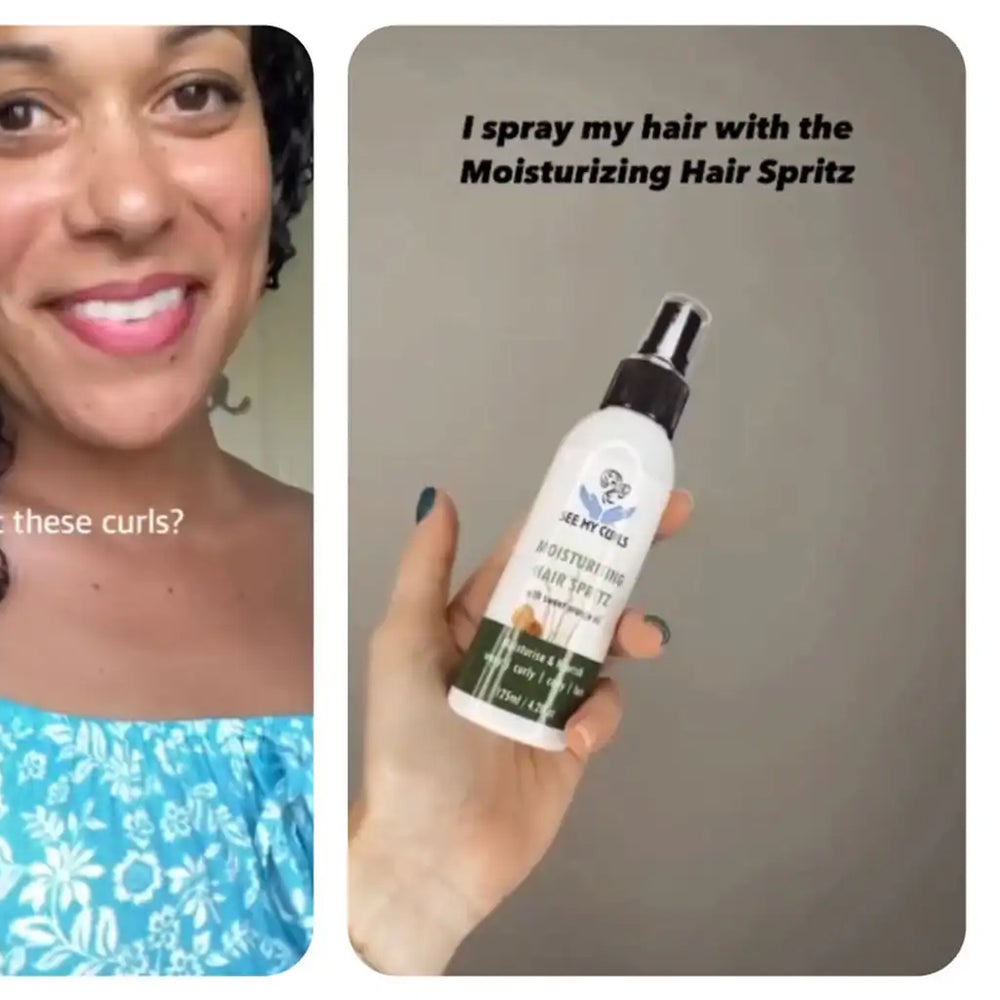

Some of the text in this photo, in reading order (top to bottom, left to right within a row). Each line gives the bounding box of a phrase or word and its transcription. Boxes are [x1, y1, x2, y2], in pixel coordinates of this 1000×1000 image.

[580, 518, 599, 533] MY
[599, 526, 629, 548] CULS
[536, 539, 625, 587] MOISTURIING
[513, 664, 537, 681] curly
